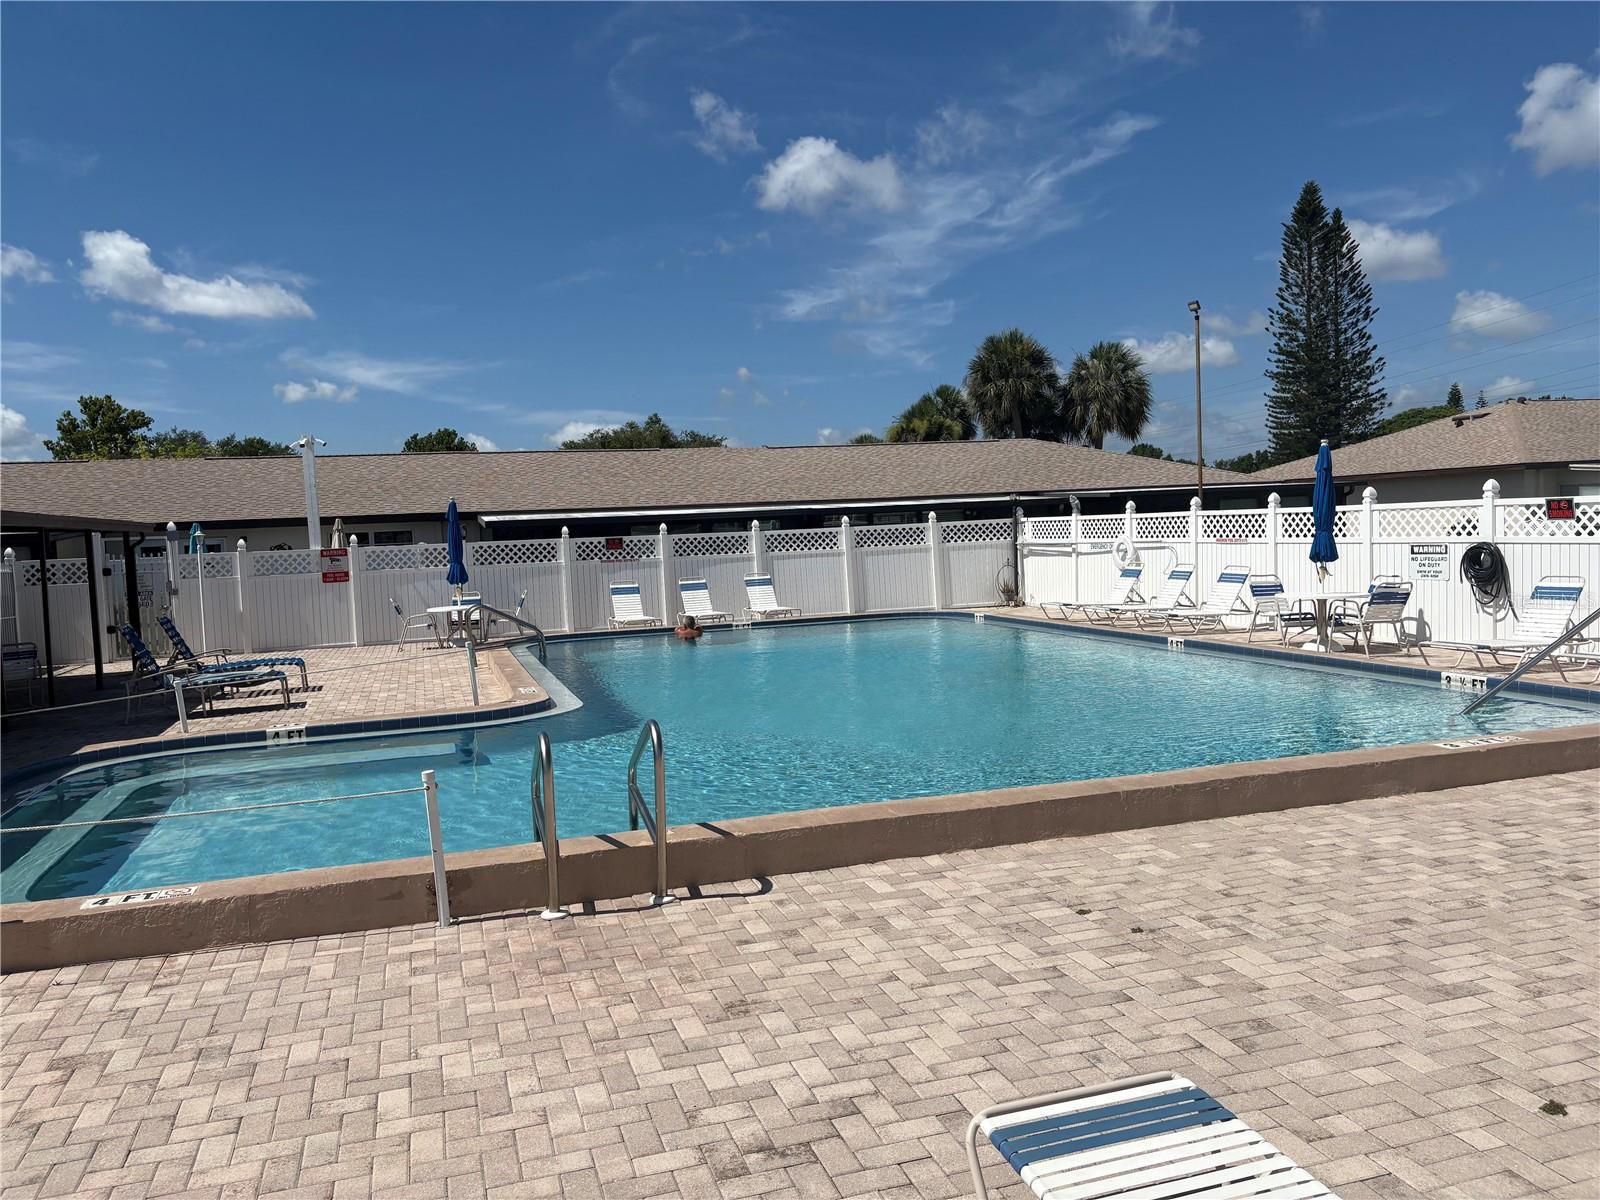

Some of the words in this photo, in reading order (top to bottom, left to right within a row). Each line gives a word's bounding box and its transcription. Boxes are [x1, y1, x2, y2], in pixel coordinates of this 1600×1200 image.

[1551, 501, 1559, 509] NO
[1549, 510, 1573, 518] SMOKING
[1413, 546, 1446, 554] WARNING
[1472, 678, 1486, 688] FT
[288, 730, 303, 739] FT
[92, 898, 110, 906] 4
